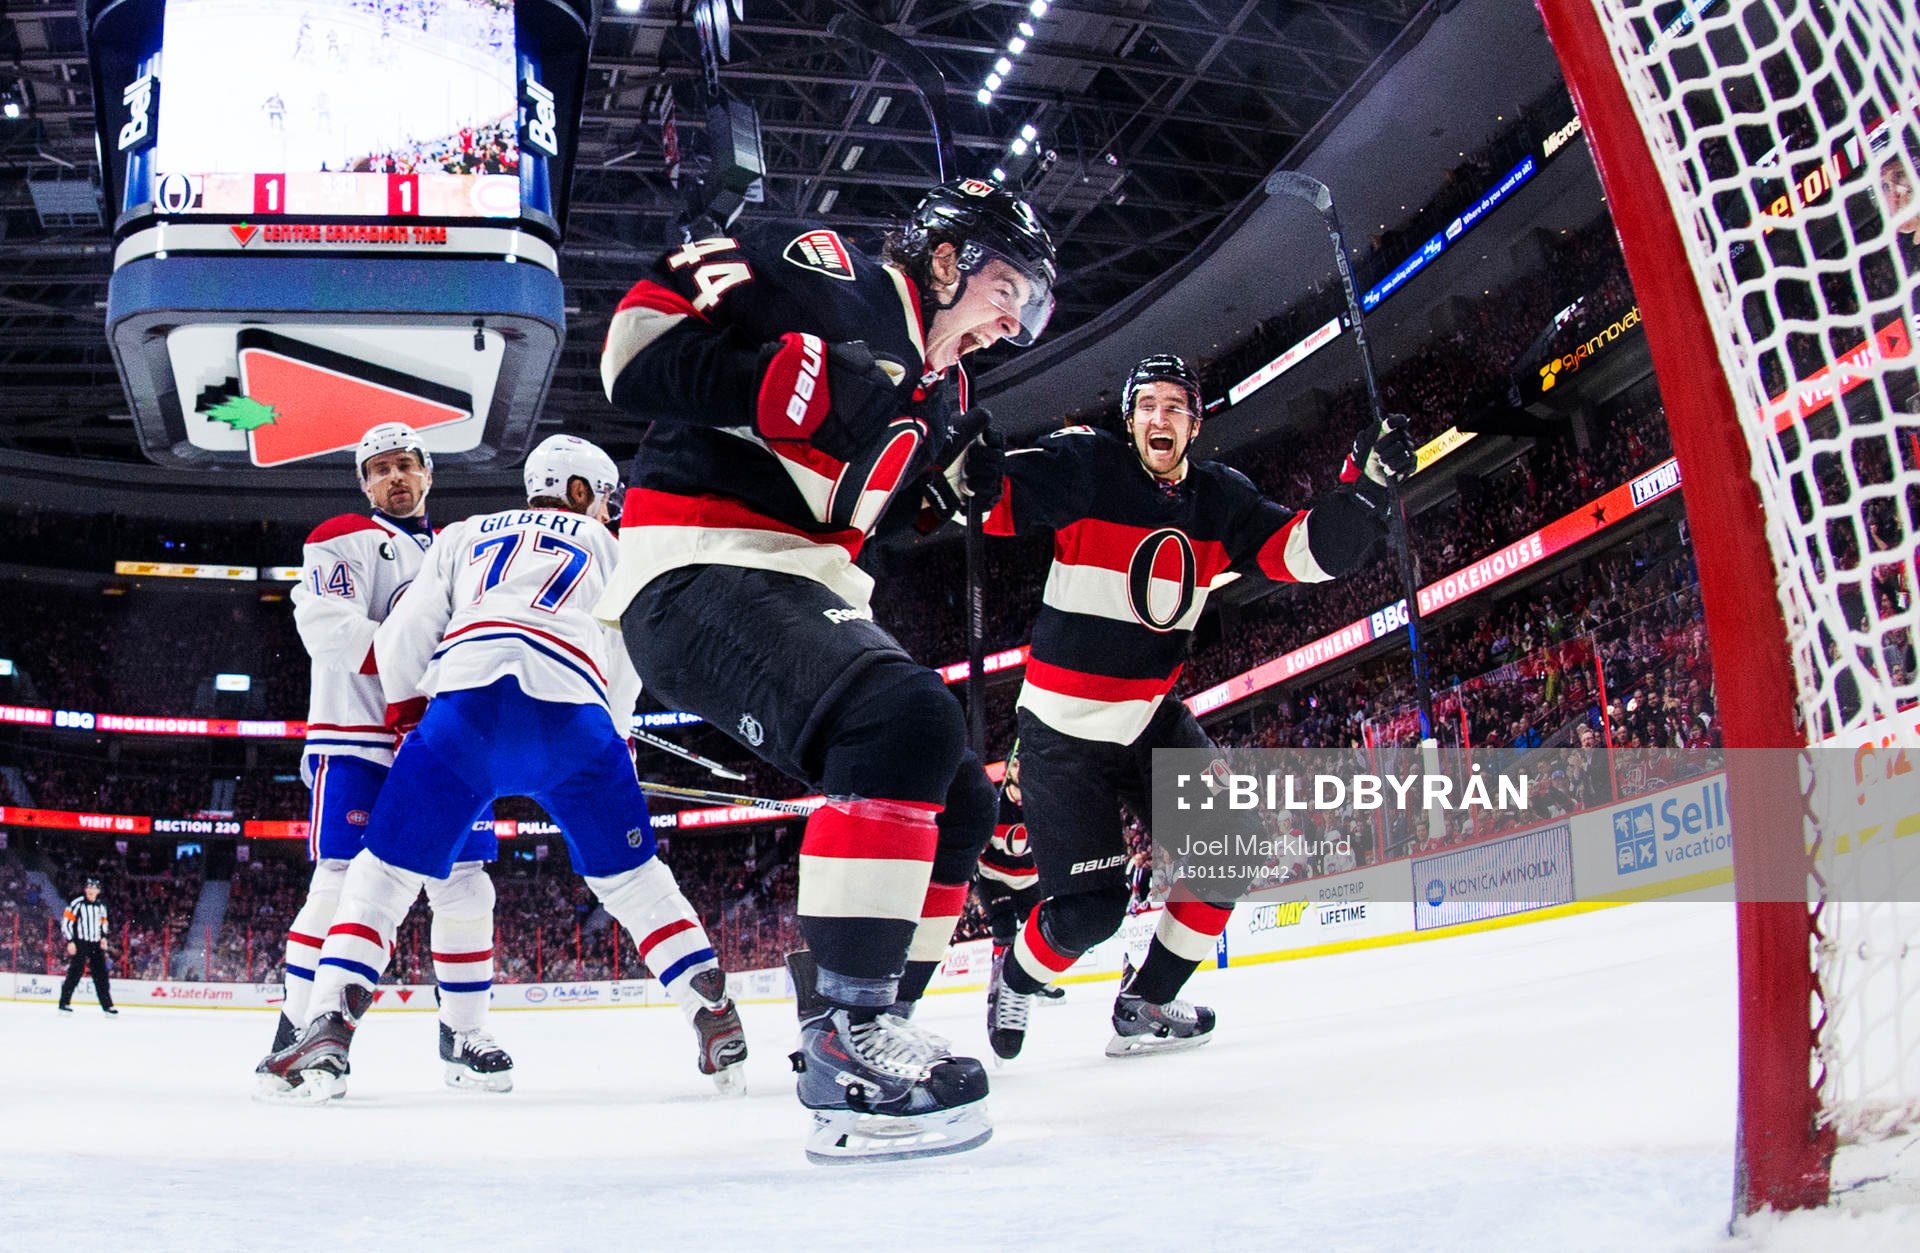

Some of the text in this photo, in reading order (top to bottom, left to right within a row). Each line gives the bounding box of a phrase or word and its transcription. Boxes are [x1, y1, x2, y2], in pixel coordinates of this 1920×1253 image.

[118, 74, 151, 150] Bell
[527, 77, 558, 155] Bell
[265, 179, 279, 211] 1
[398, 181, 412, 213] 1
[263, 224, 448, 244] CENTRE CANADIAN TIRE
[810, 235, 843, 268] OTTAWA
[666, 236, 755, 311] 44
[480, 513, 586, 536] GILBERT
[312, 561, 355, 599] 14
[469, 530, 592, 614] 77
[1286, 625, 1364, 673] SOUTHERN
[1421, 535, 1544, 612] SMOKEHOUSE
[102, 716, 207, 733] SMOKEHOUSE
[79, 815, 240, 834] VISIT US SECTION 220
[682, 811, 700, 825] OF
[704, 809, 728, 823] THE
[1662, 781, 1730, 842] Sell
[1319, 881, 1364, 899] ROADTRIP
[1450, 857, 1558, 898] KONICA MINOLTA
[1249, 897, 1310, 934] SUBWAY
[1321, 905, 1366, 925] LIFETIME
